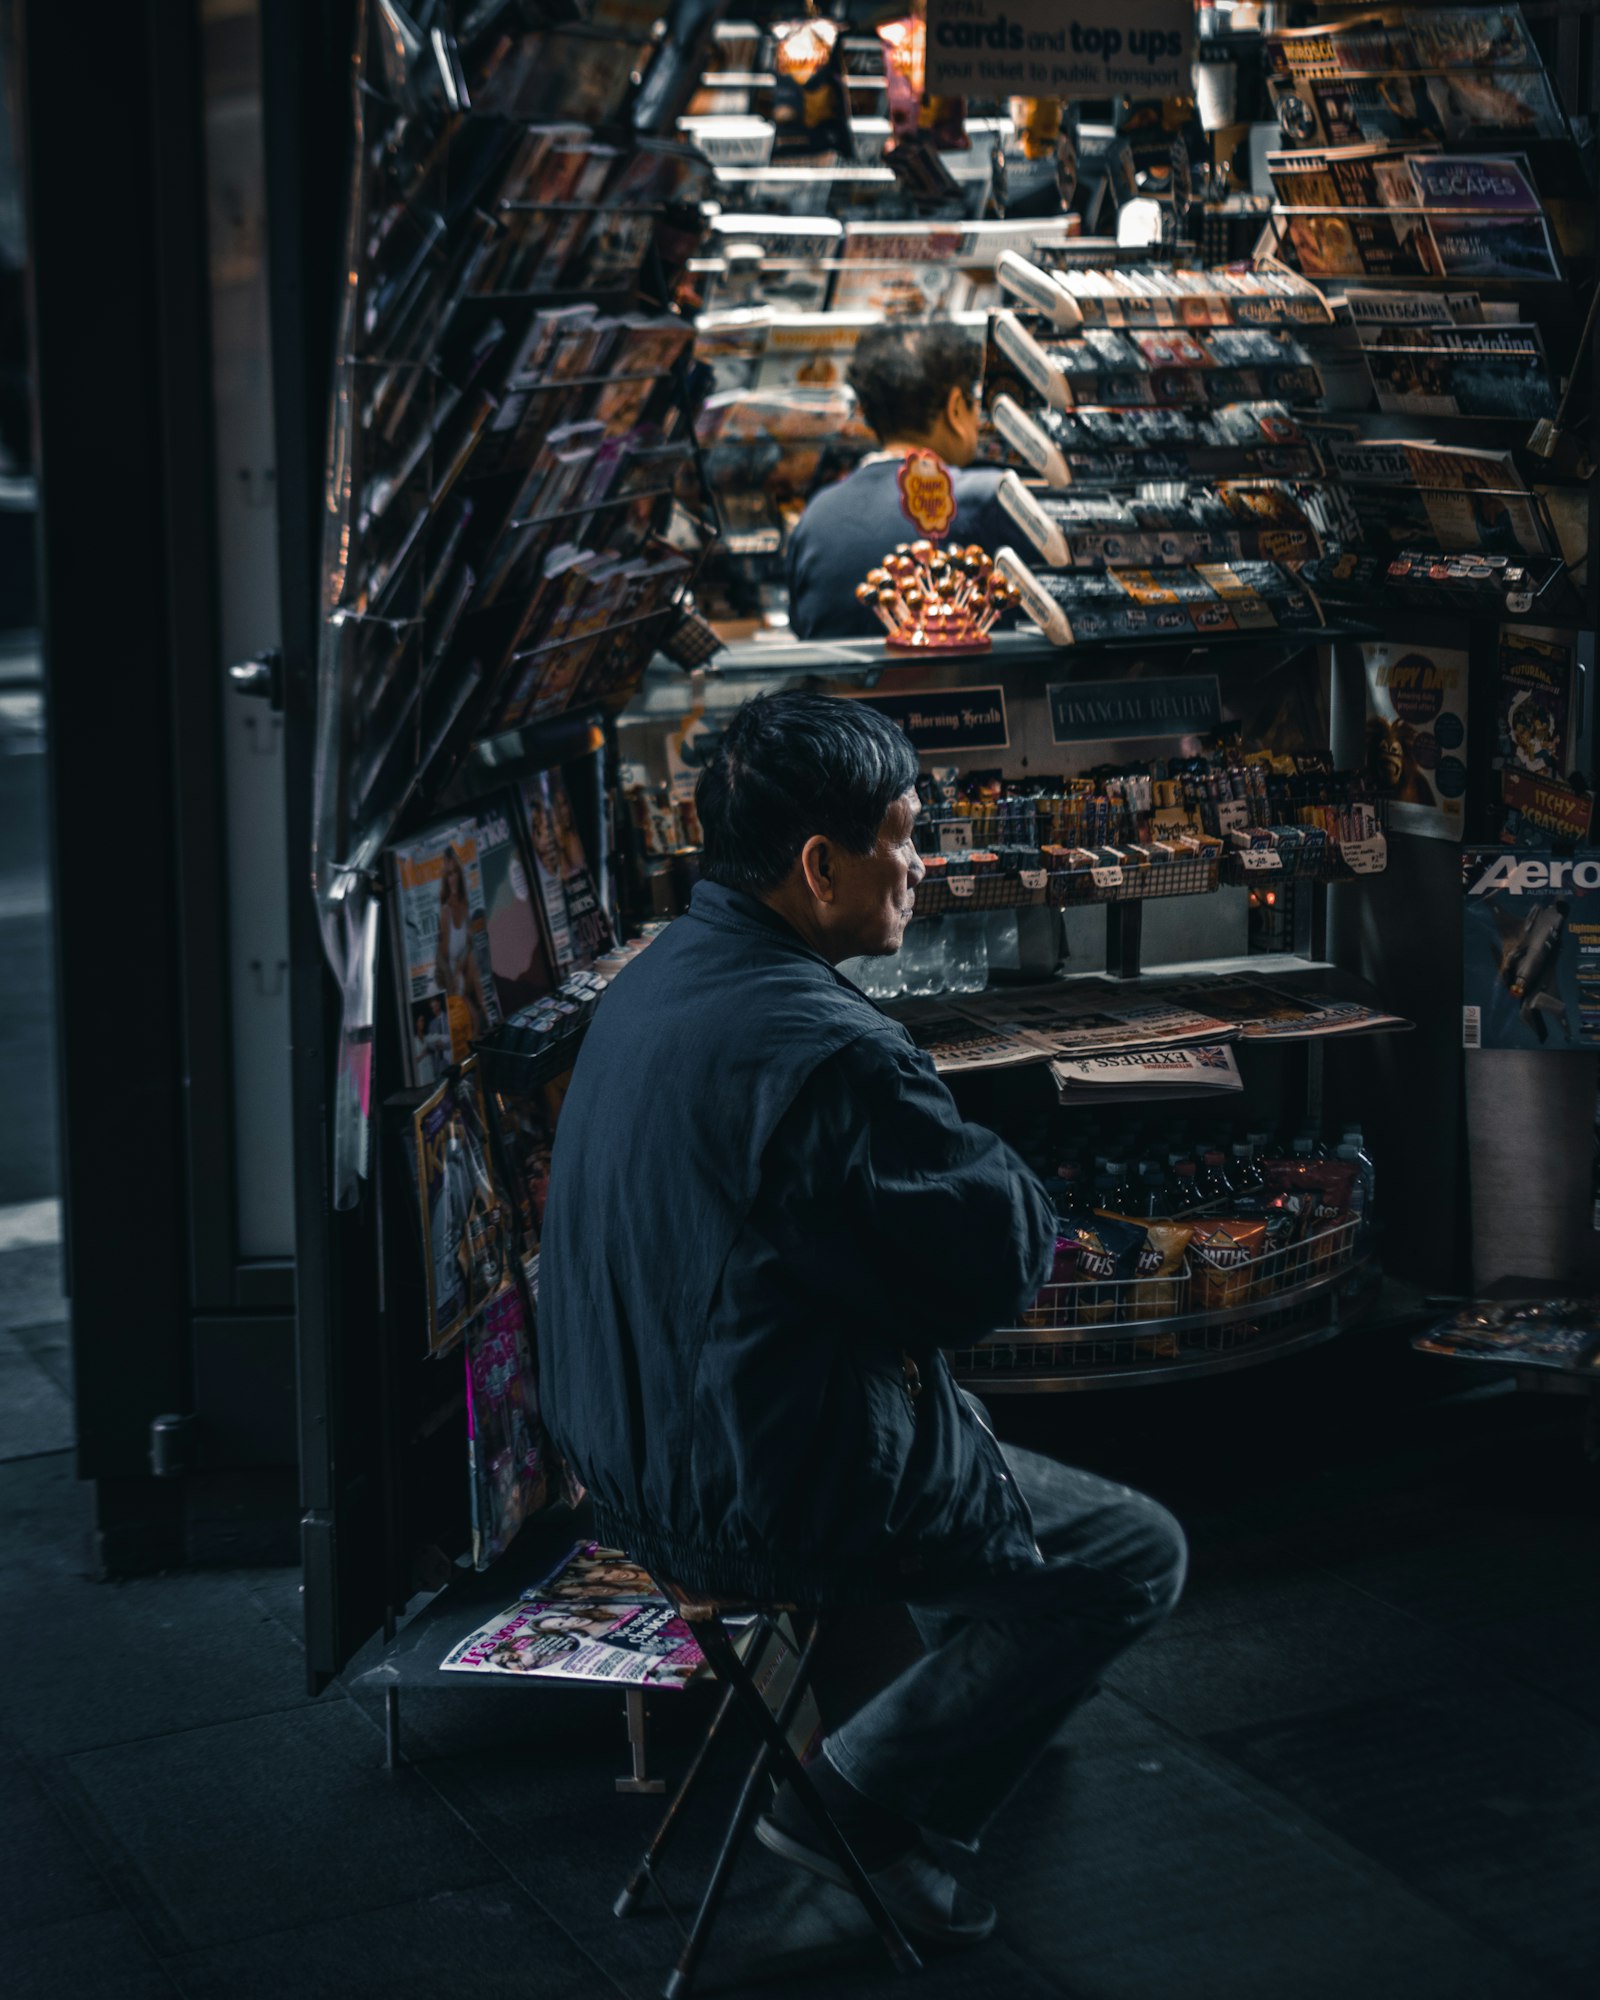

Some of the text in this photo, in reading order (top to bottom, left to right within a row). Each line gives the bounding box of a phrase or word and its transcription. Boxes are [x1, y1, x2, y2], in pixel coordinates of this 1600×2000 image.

[936, 14, 1182, 64] cards and top ups
[936, 59, 1180, 88] your ticket to public transport
[1427, 175, 1516, 196] ESCAPES
[1447, 332, 1538, 367] Marketing
[1337, 454, 1375, 471] GOLF
[1375, 667, 1459, 689] HAPPY DAYS
[909, 712, 960, 730] Morning
[961, 707, 1000, 729] Herald
[1058, 695, 1213, 724] FINANCIAL REVIEW
[1535, 788, 1576, 817] ITCHY
[1521, 803, 1586, 841] SCRATCHY
[1467, 854, 1600, 896] Aero
[1094, 1051, 1190, 1068] EXPRESS
[1077, 1250, 1114, 1276] ITH'S
[460, 1642, 498, 1667] It's
[489, 1614, 529, 1642] your
